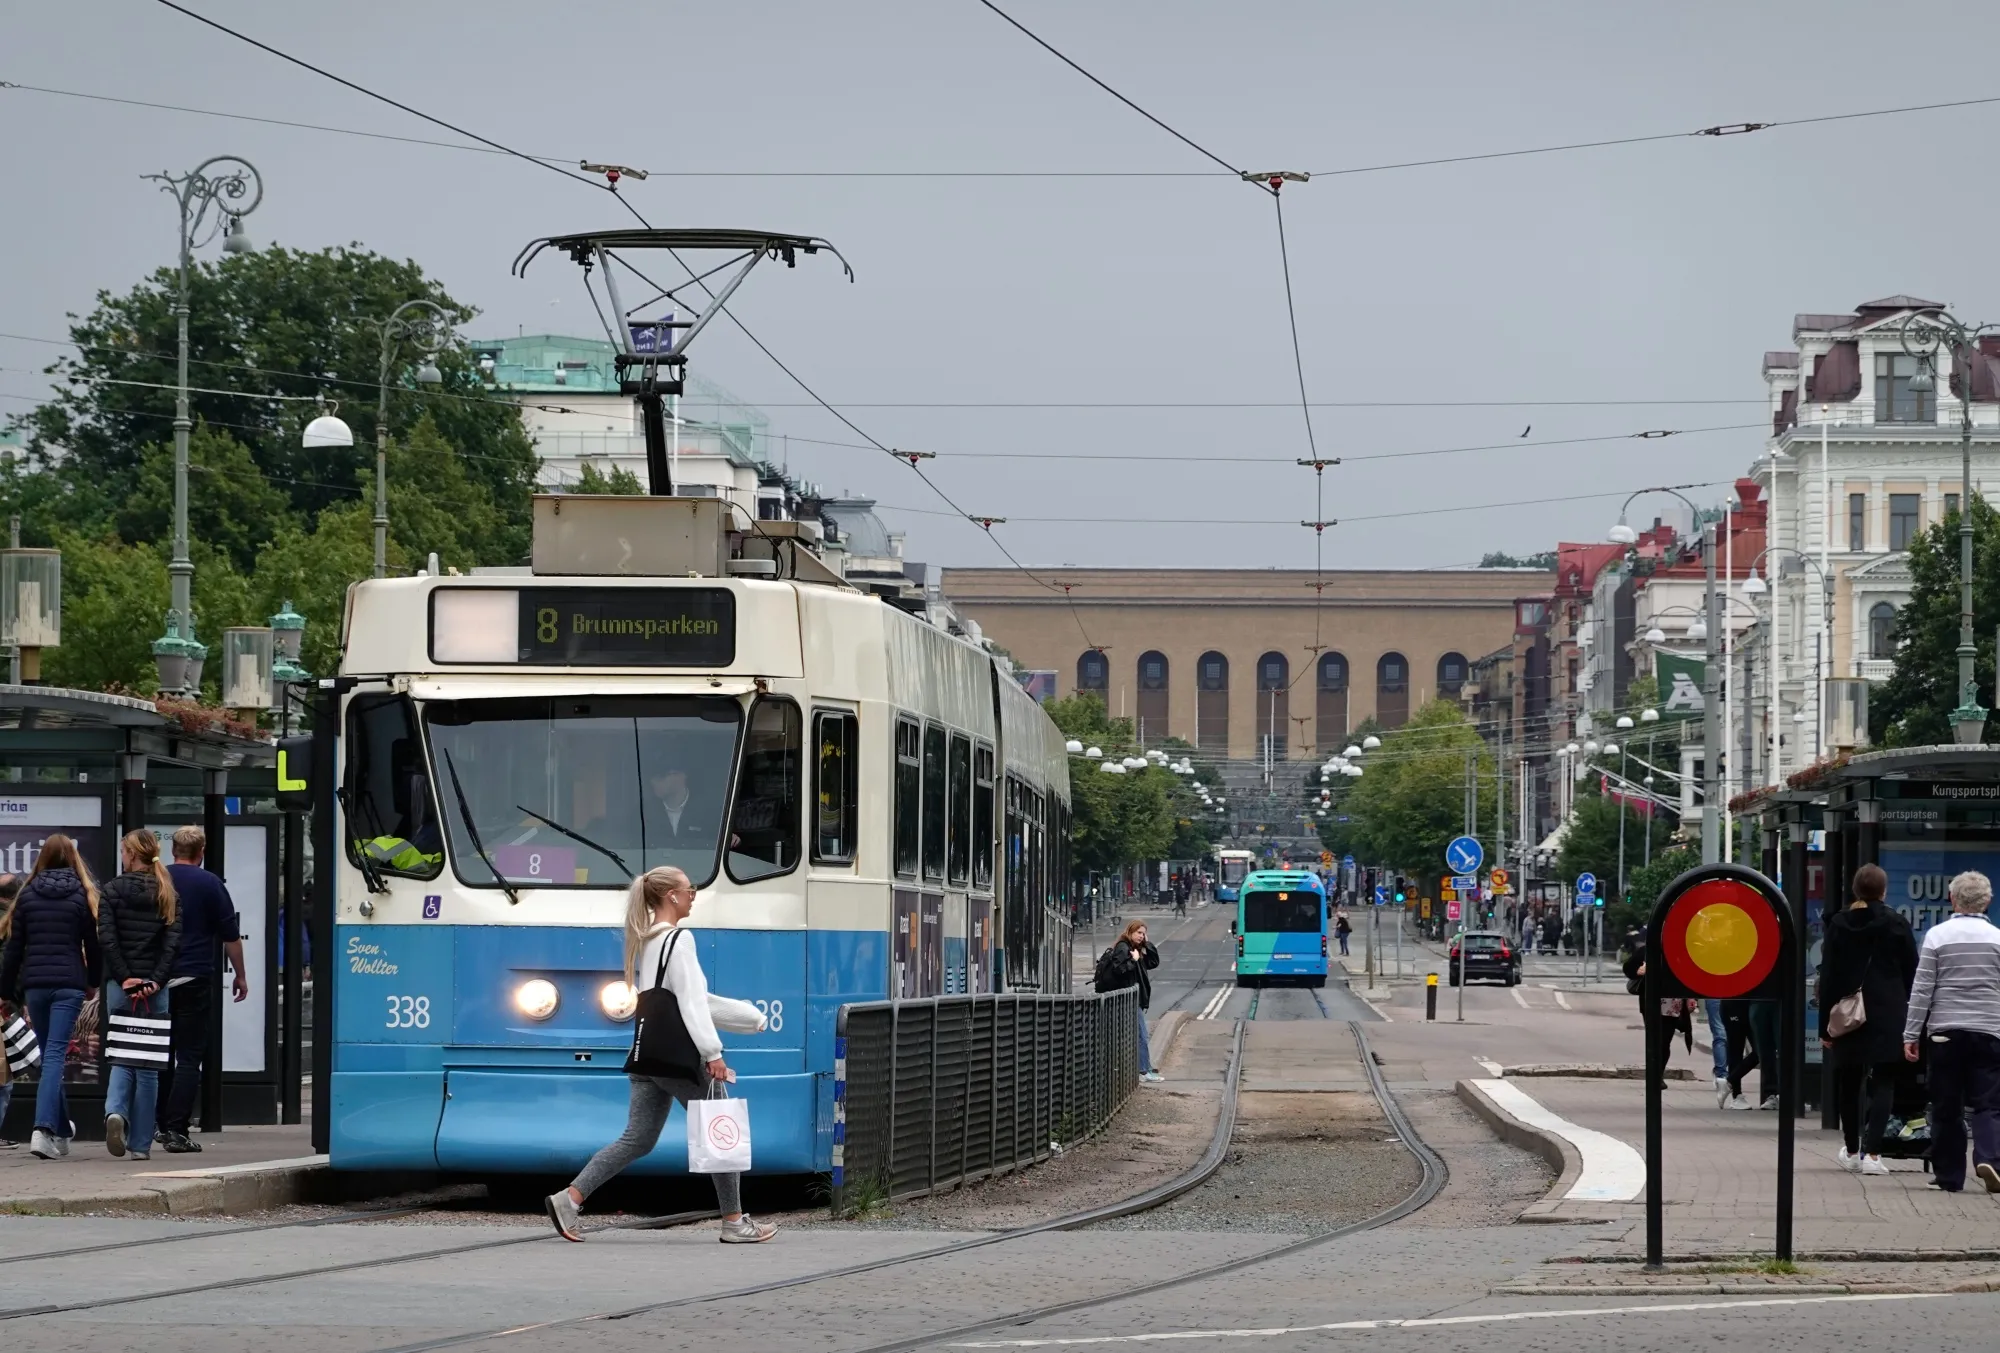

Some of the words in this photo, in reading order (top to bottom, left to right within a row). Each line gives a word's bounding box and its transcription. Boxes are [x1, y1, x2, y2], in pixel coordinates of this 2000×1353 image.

[537, 608, 558, 643] 8
[572, 613, 718, 640] Brunnsparken
[1854, 810, 1938, 820] Kportsplatsen
[529, 853, 541, 875] 8
[346, 936, 380, 955] Sven
[350, 956, 399, 975] Wollter
[386, 995, 430, 1029] 338
[741, 999, 783, 1032] 38
[126, 1026, 154, 1035] SEPHORA
